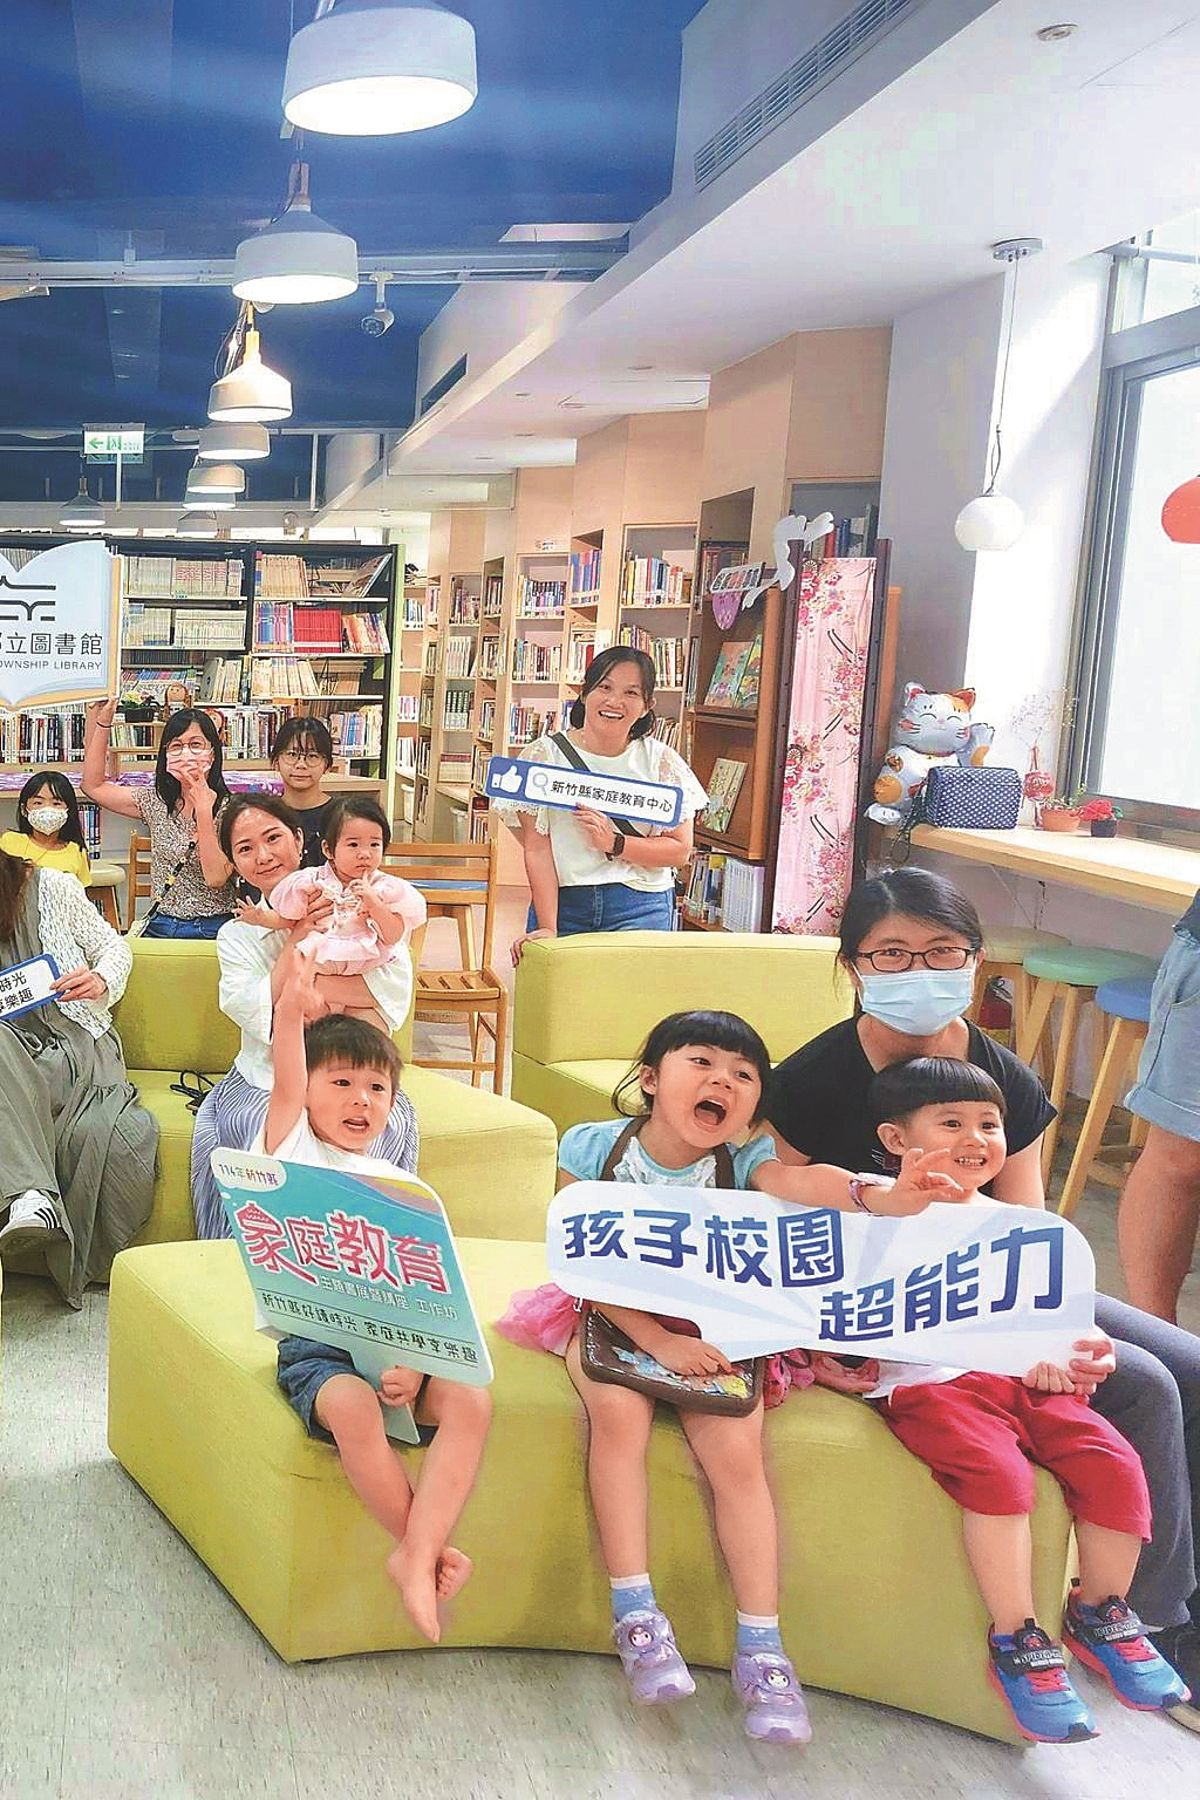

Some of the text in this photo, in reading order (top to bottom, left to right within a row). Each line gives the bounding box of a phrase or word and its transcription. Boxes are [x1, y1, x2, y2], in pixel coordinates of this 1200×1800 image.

[53, 660, 102, 670] LIBRARY
[550, 780, 673, 813] 新竹縣家庭教育中心
[236, 1203, 452, 1294] 家庭教育
[561, 1206, 845, 1288] 孩子校園
[818, 1226, 1065, 1343] 超能力
